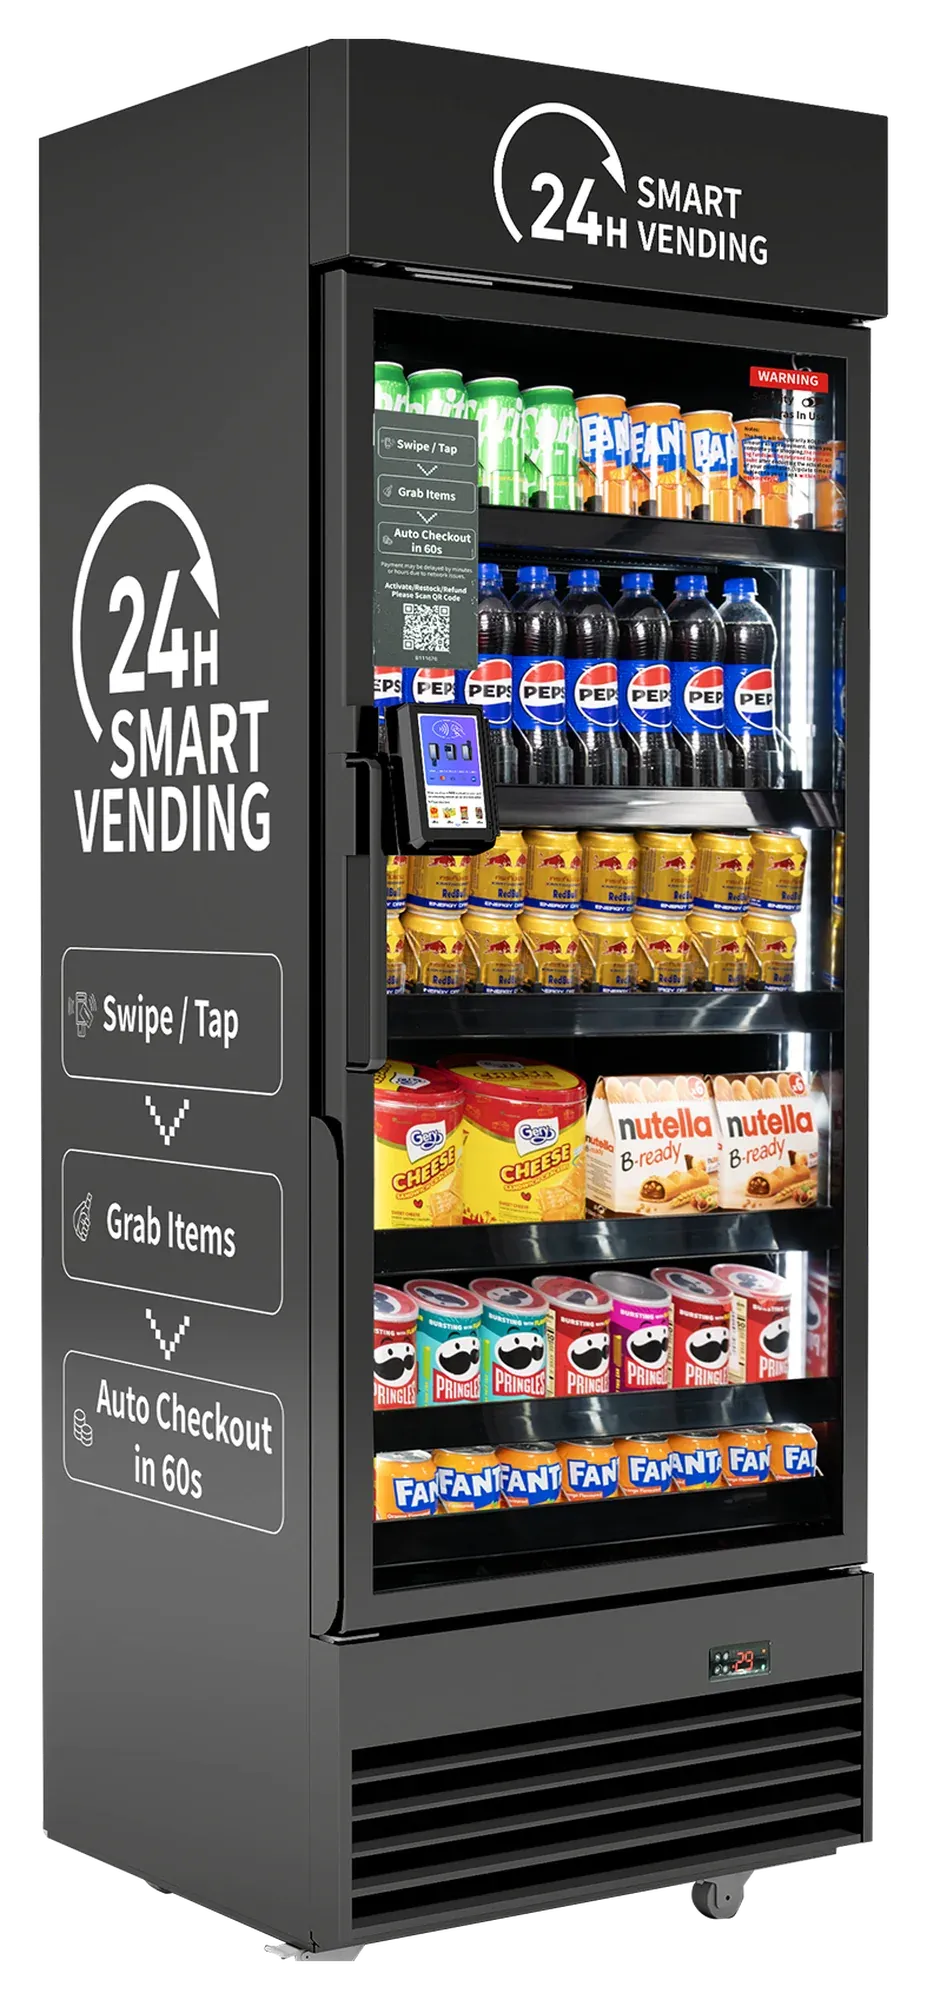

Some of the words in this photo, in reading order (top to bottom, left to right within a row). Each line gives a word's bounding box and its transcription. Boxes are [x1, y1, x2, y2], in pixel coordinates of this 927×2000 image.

[531, 172, 627, 249] 24H
[637, 175, 743, 219] SMART
[637, 219, 768, 266] VENDING
[757, 370, 819, 386] WARNING
[797, 411, 806, 420] In
[397, 438, 430, 453] Swipe
[431, 442, 437, 454] /
[438, 443, 458, 456] Tap
[398, 487, 424, 499] Grab
[426, 489, 456, 502] Items
[394, 528, 420, 540] Auto
[421, 530, 471, 544] Checkout
[411, 542, 422, 553] in
[424, 543, 443, 555] 60s
[391, 590, 414, 599] Please
[415, 592, 431, 600] Scan
[432, 593, 443, 602] QR
[443, 594, 461, 602] Code
[109, 569, 218, 694] 24H
[110, 699, 270, 781] SMART
[74, 781, 271, 853] VENDING
[103, 993, 174, 1043] Swipe
[178, 996, 189, 1044] /
[194, 998, 240, 1049] Tap
[618, 1107, 712, 1140] nutella
[726, 1104, 813, 1138] nutella
[392, 1146, 456, 1192] CHEESE
[499, 1143, 571, 1184] CHEESE
[620, 1139, 682, 1172] B-ready
[729, 1136, 785, 1169] B-ready
[106, 1202, 160, 1246] Grab
[168, 1210, 236, 1258] Items
[429, 1319, 463, 1331] BURSTING
[488, 1313, 522, 1327] BURSTING
[560, 1316, 595, 1328] BURSTING
[620, 1308, 655, 1320] BURSTING
[679, 1308, 714, 1321] BURSTING
[495, 1367, 546, 1396] PRINGLES
[96, 1378, 150, 1426] Auto
[156, 1391, 273, 1456] Checkout
[134, 1443, 156, 1485] in
[162, 1452, 203, 1500] 60s
